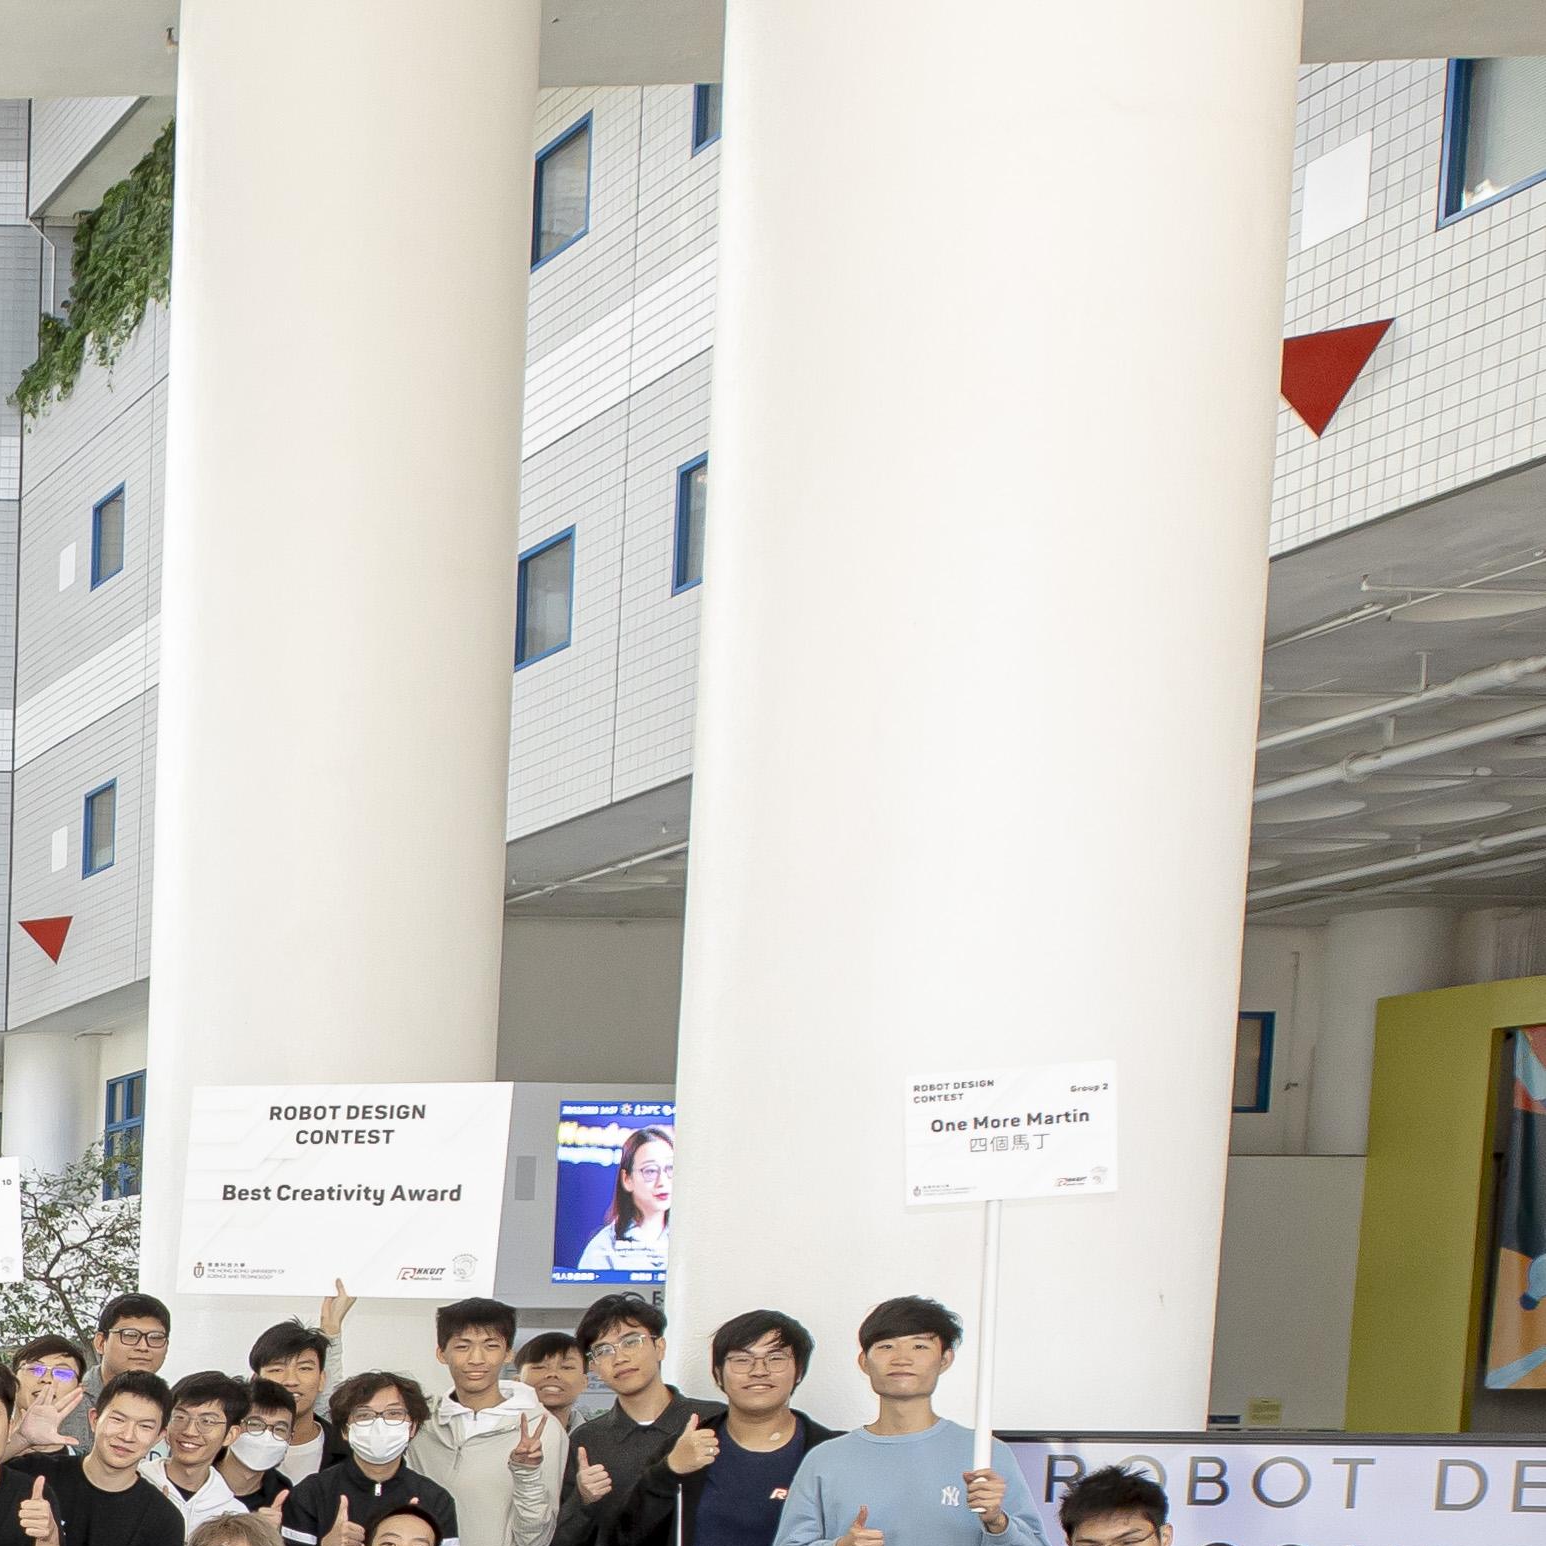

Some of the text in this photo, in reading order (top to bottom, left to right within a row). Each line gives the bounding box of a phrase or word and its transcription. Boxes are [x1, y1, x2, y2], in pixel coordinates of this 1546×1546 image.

[913, 1080, 994, 1092] ROBOT DESIGN
[914, 1093, 964, 1104] CONTEST
[270, 1105, 425, 1120] ROBOT DESIGN
[931, 1109, 1090, 1133] One More Martin
[296, 1130, 394, 1144] CONTEST
[970, 1133, 1050, 1152] 四個馬丁
[223, 1184, 461, 1206] Best Creativity Award
